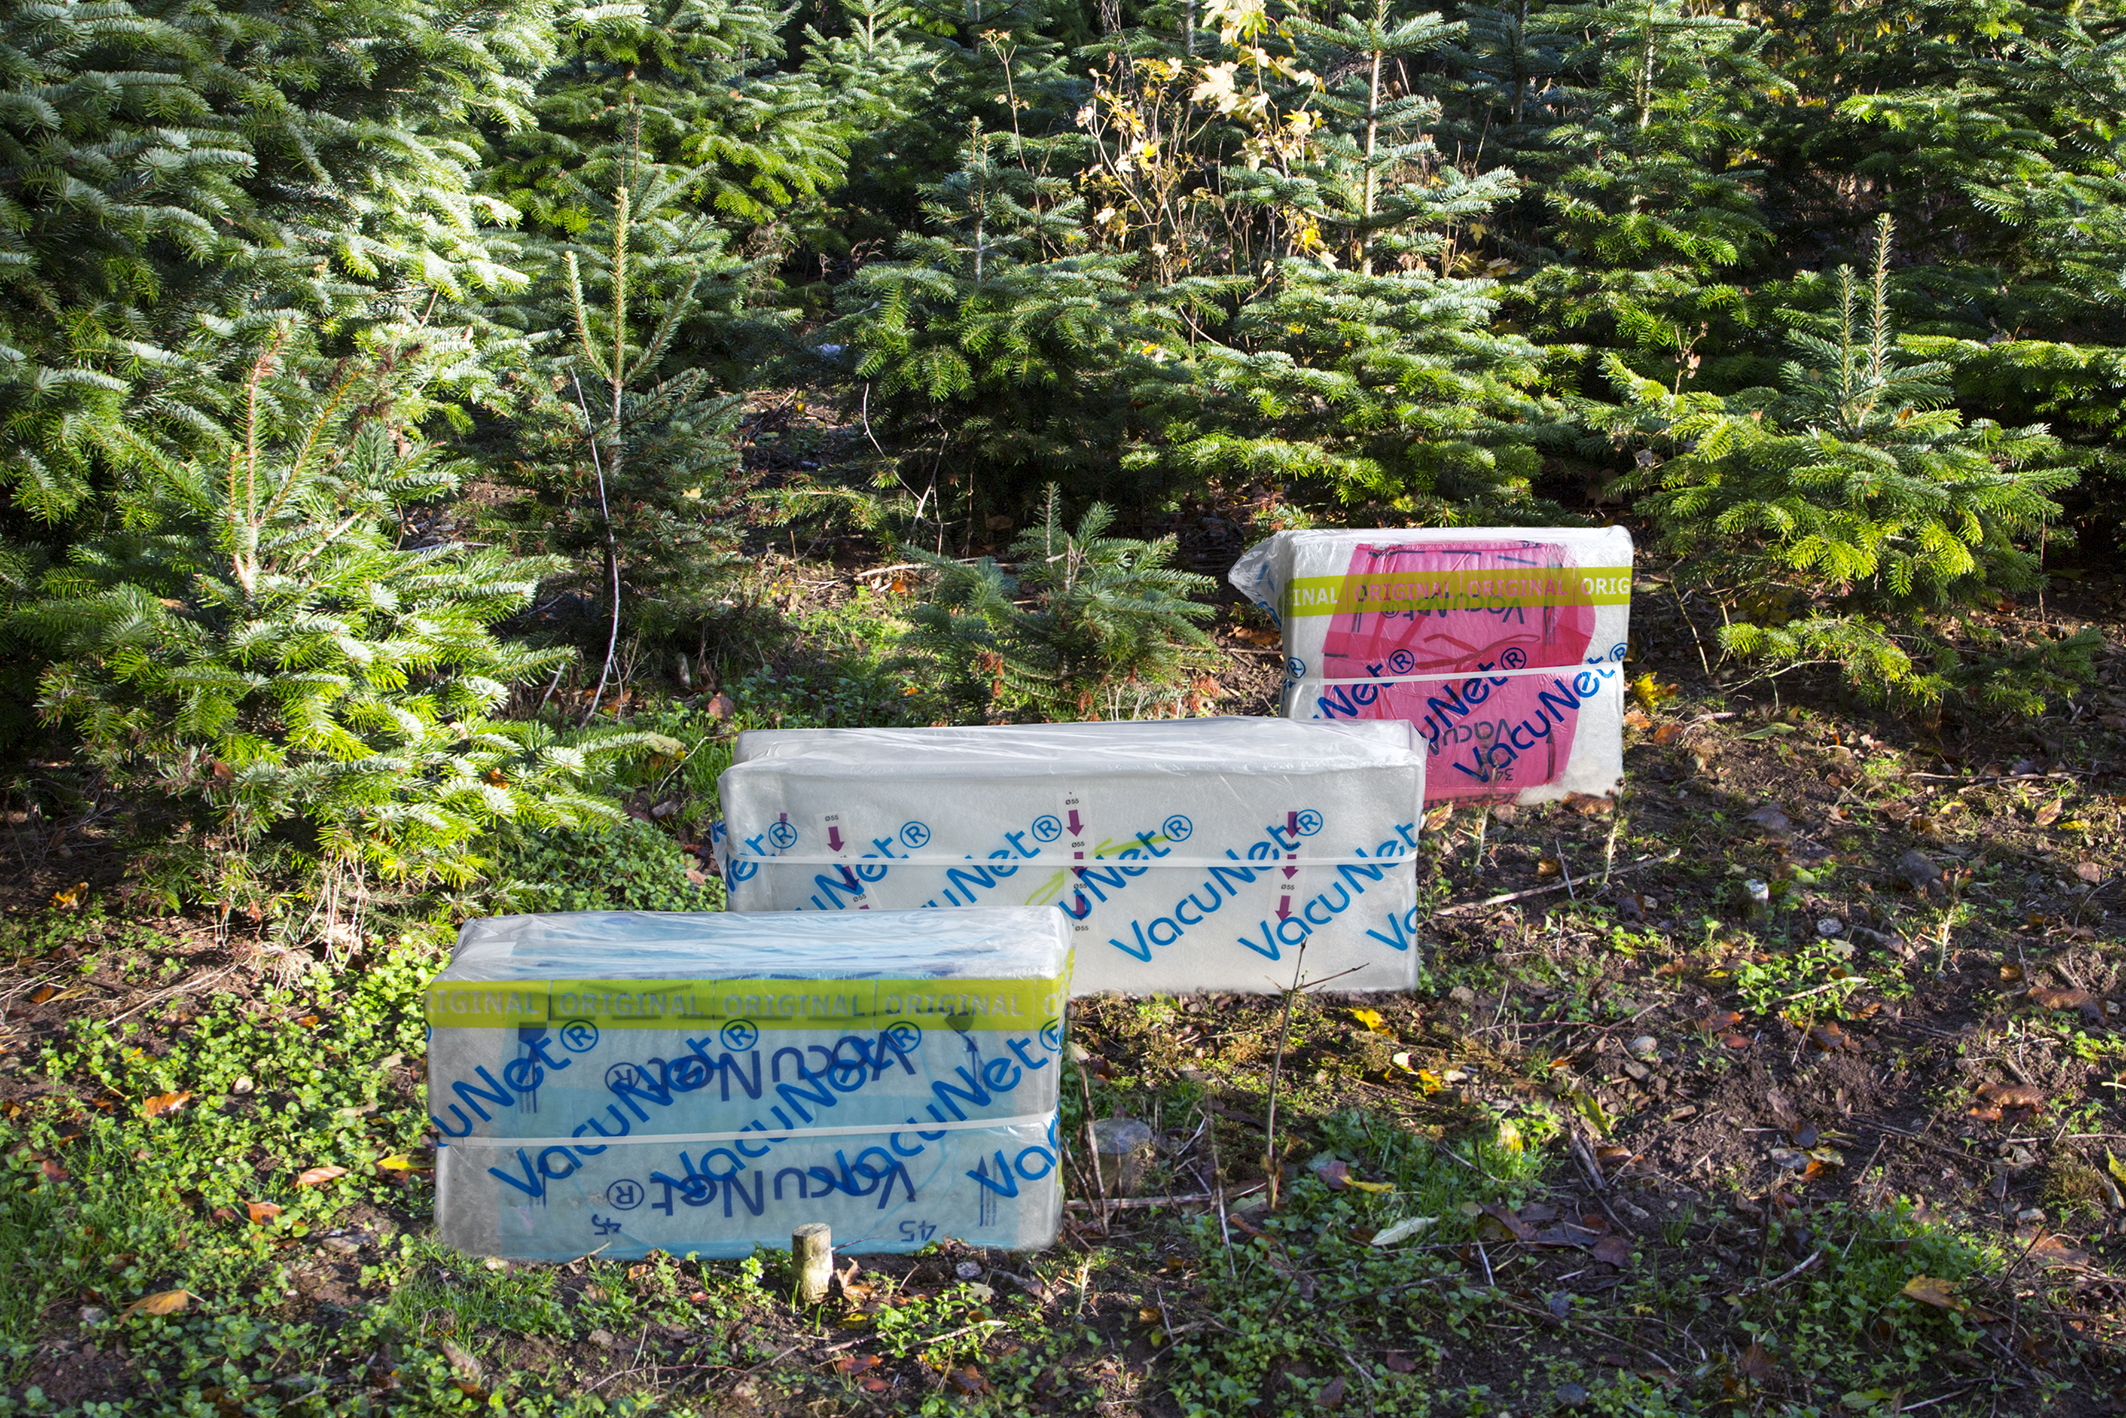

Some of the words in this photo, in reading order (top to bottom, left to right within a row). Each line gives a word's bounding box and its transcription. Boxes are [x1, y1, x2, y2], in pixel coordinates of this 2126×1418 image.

[1353, 581, 1455, 602] ORIGINAL
[1467, 577, 1568, 598] ORIGINAL
[559, 992, 704, 1017] ORIGINAL
[723, 994, 866, 1017] ORIGINAL
[884, 994, 1024, 1017] ORIGINAL
[899, 1220, 938, 1242] 45
